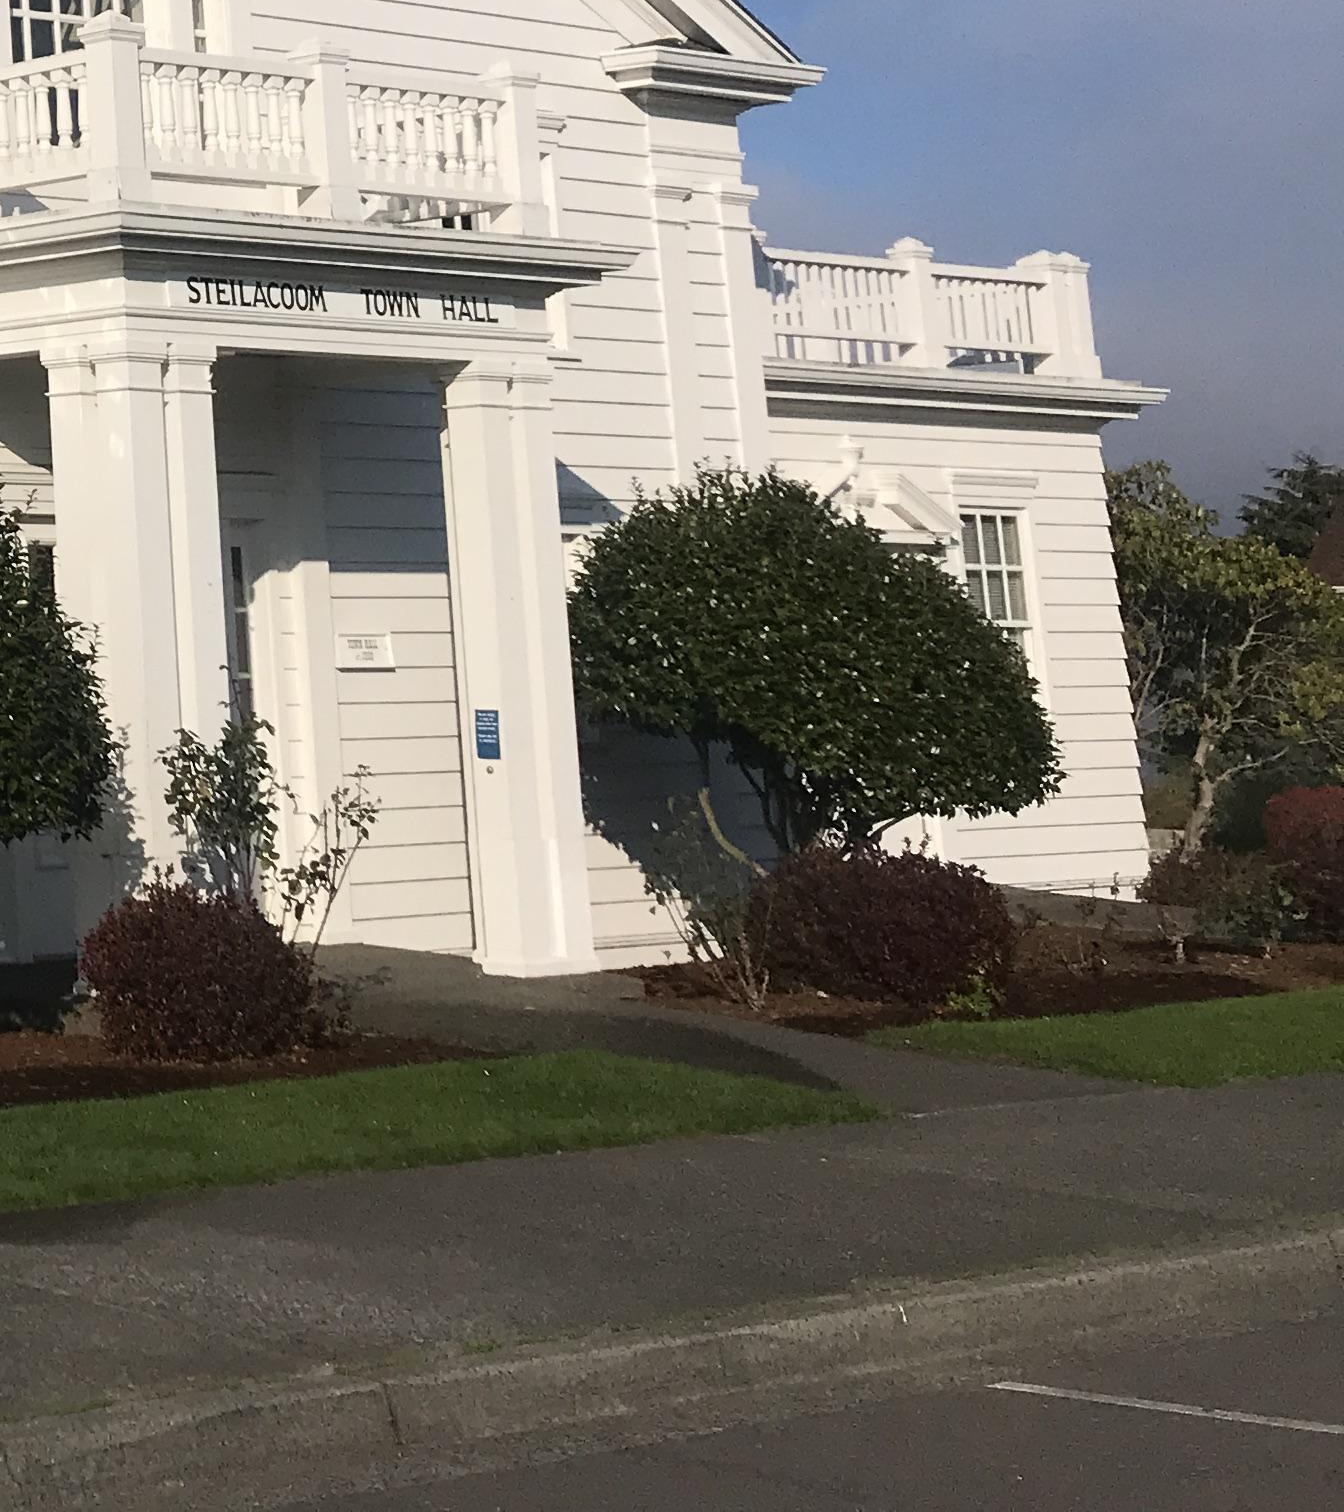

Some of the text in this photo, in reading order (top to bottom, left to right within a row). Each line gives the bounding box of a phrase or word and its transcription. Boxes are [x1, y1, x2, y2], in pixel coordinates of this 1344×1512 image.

[186, 276, 499, 323] STEILACOOM TOWN HALL
